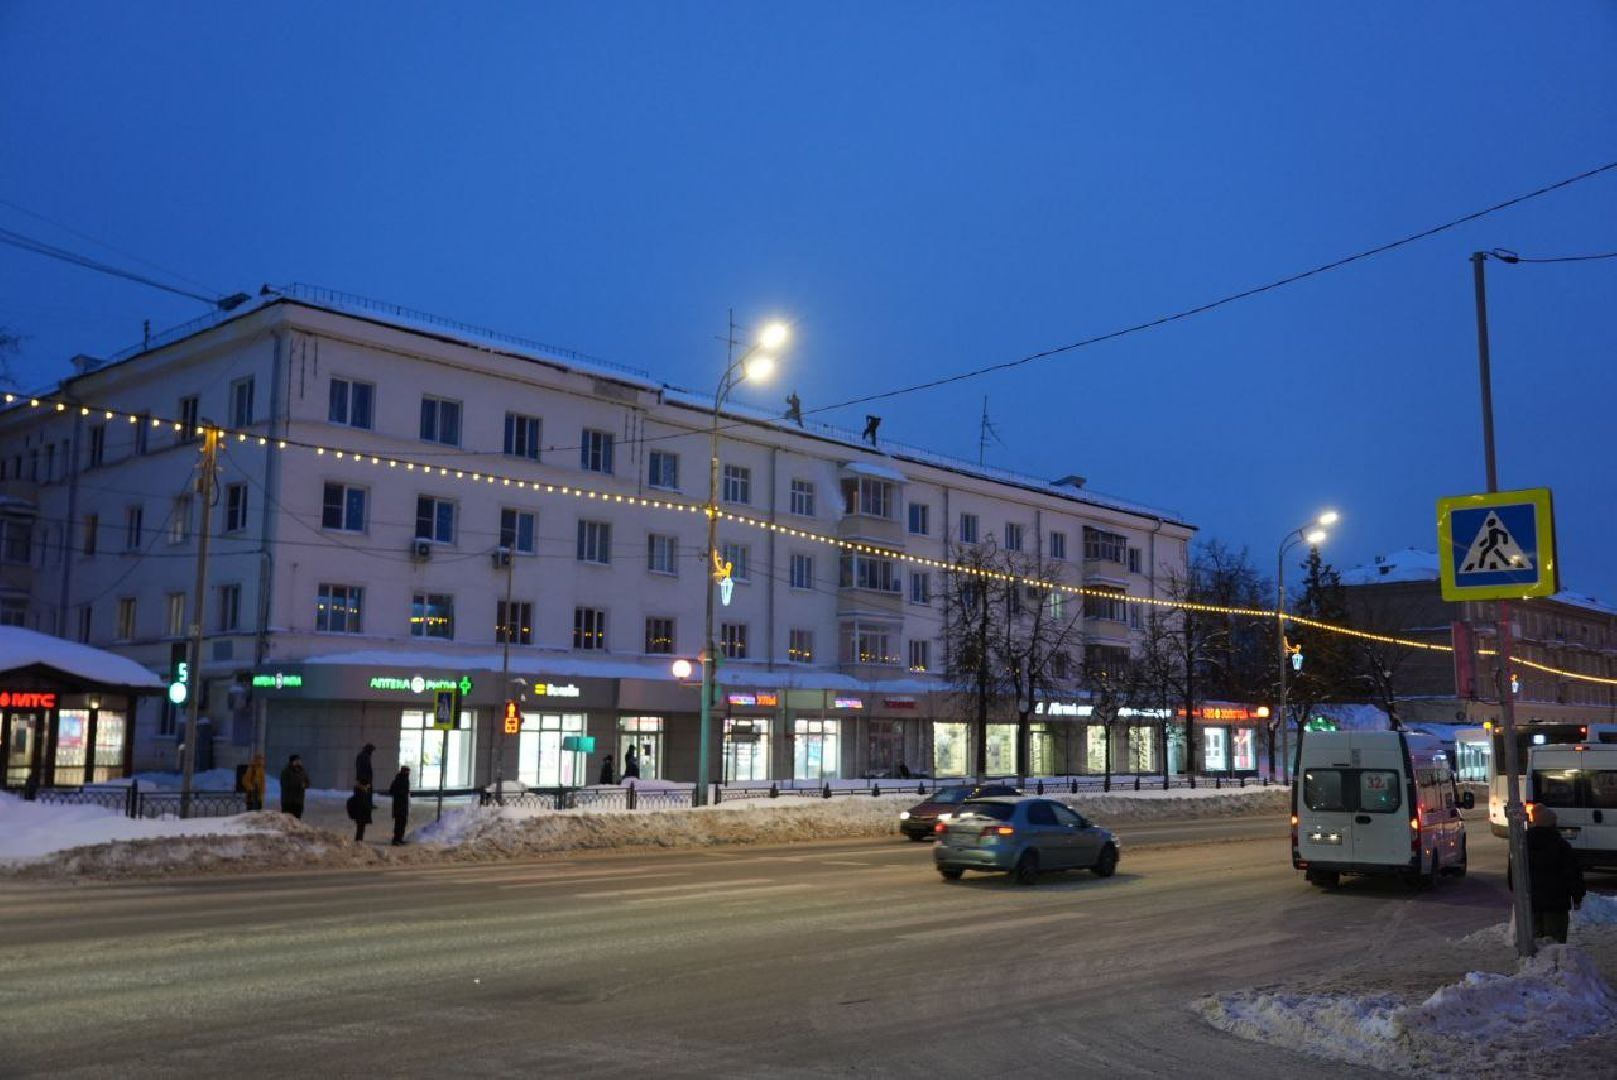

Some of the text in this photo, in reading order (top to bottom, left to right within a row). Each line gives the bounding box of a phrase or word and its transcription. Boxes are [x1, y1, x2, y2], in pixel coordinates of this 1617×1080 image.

[179, 663, 188, 683] 5
[370, 678, 411, 690] АПТЕКА
[12, 693, 56, 708] МТС
